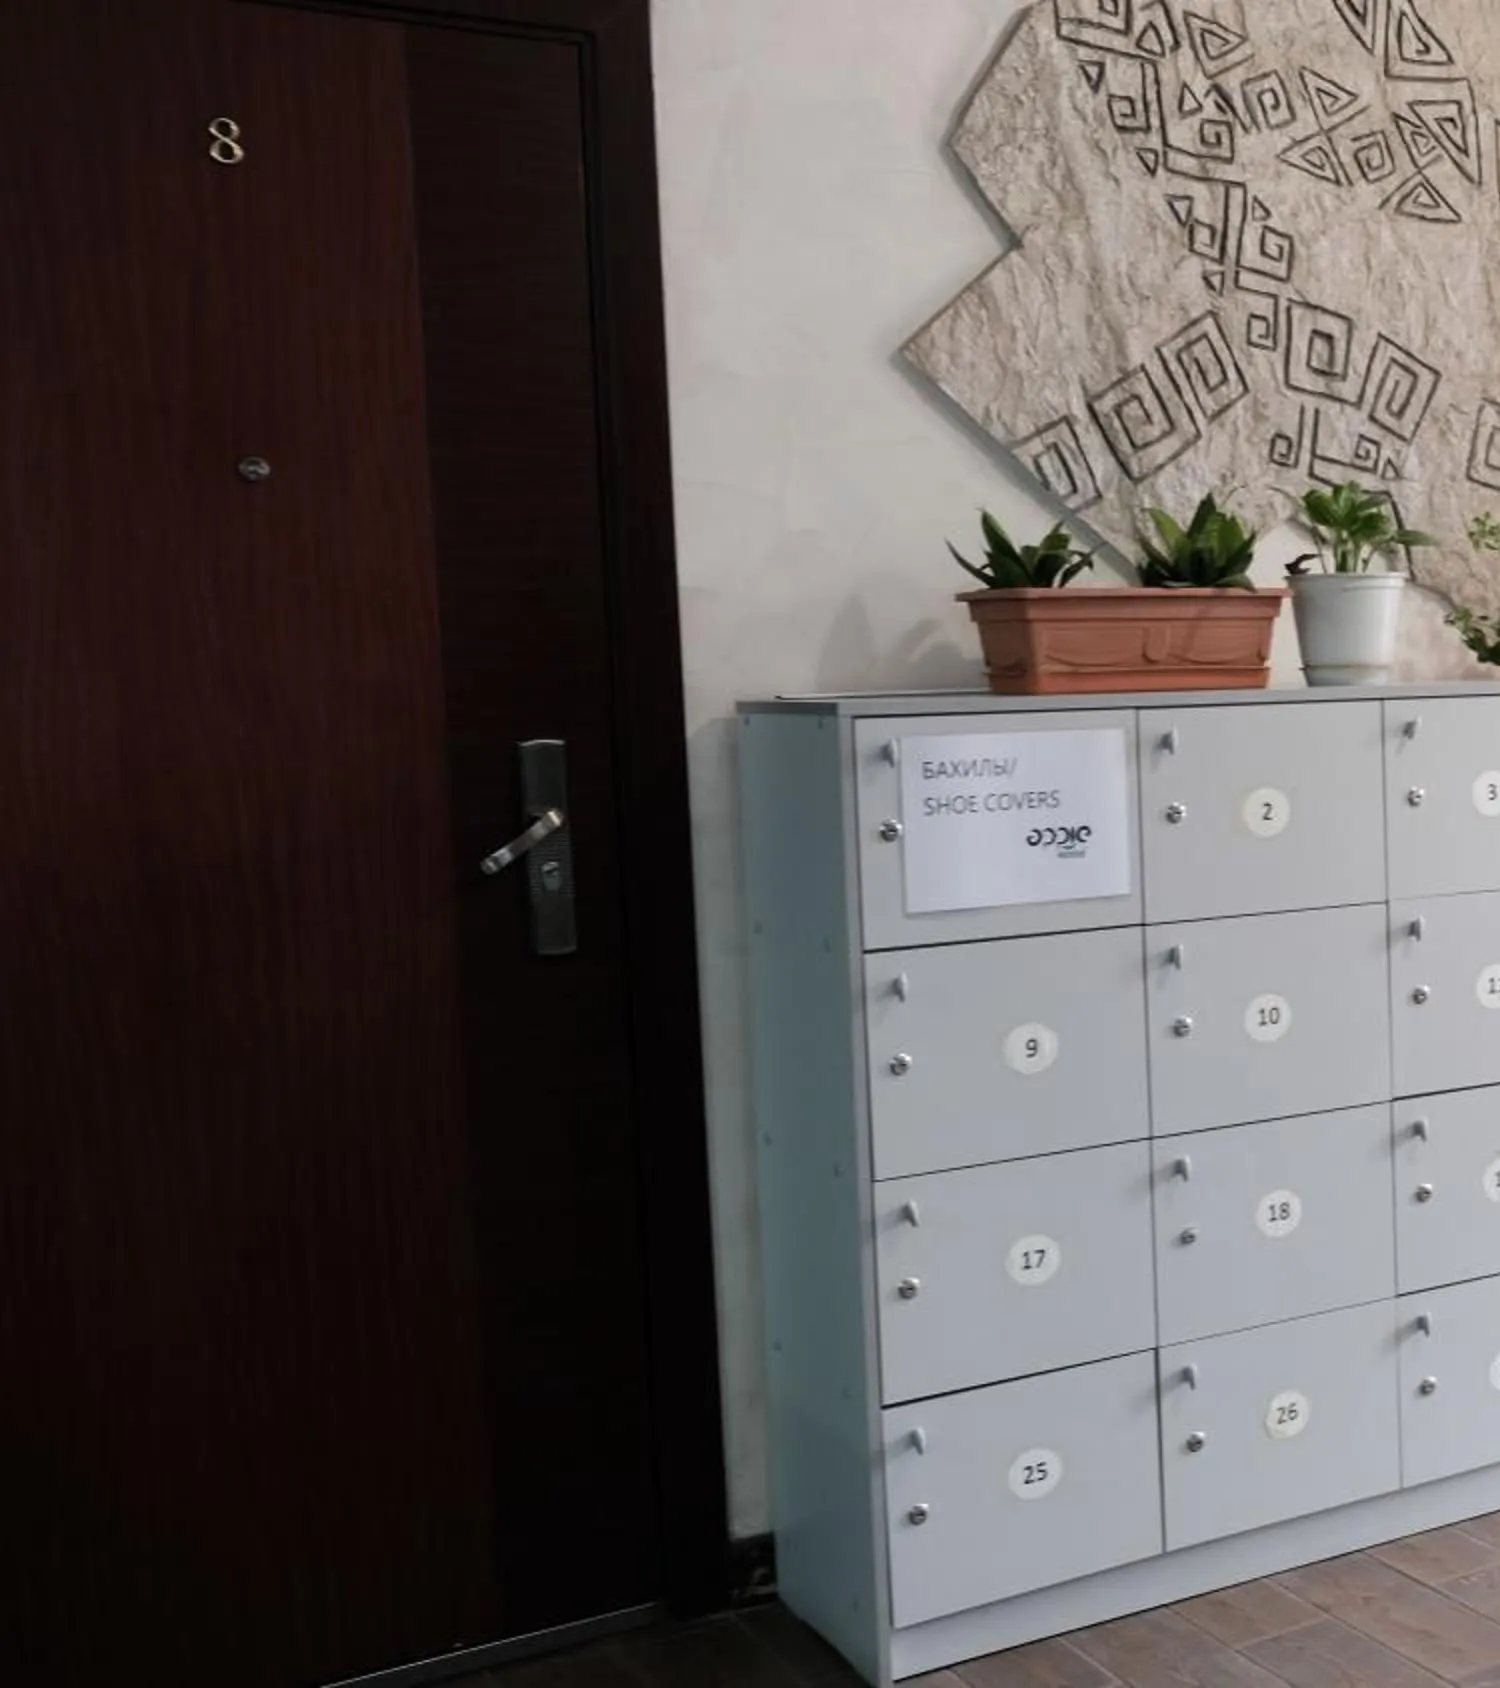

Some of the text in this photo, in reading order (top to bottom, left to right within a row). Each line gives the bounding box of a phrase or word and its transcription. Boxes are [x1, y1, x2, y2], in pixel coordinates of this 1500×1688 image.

[208, 117, 245, 164] 8
[922, 758, 1018, 780] БАХИЛЫ/
[923, 790, 1061, 816] SHOE COVERS
[1258, 1007, 1280, 1027] 10
[1269, 1203, 1290, 1222] 18
[1022, 1249, 1046, 1270] 17
[1276, 1403, 1298, 1425] 26
[1024, 1462, 1048, 1484] 25
